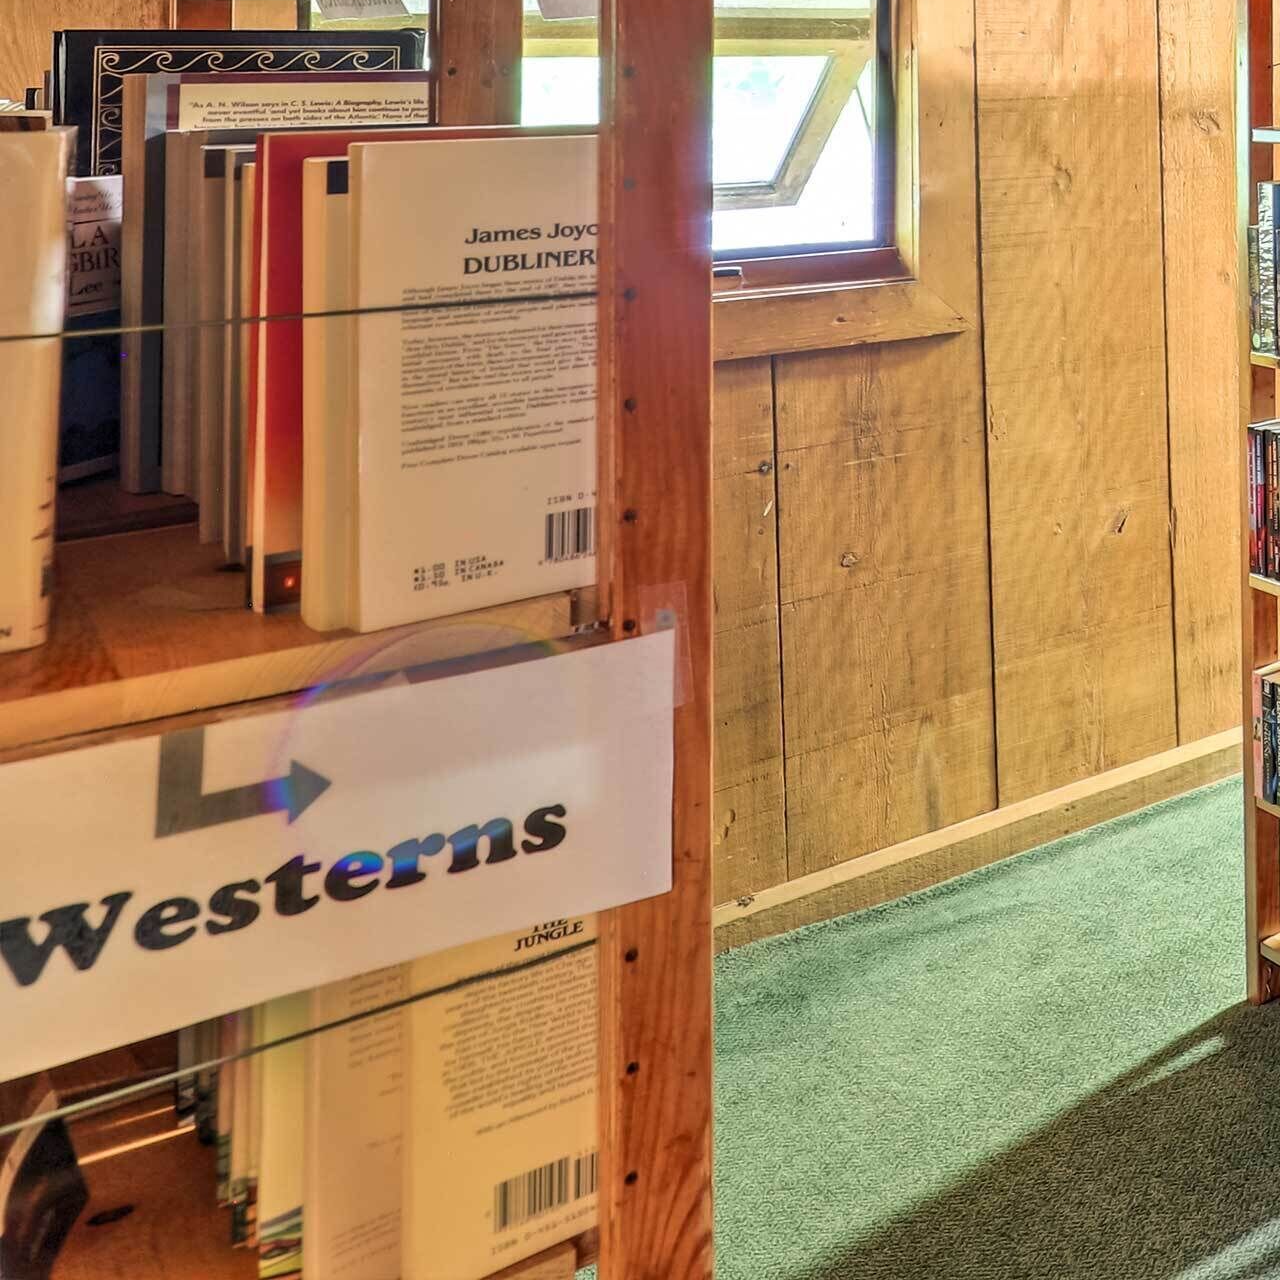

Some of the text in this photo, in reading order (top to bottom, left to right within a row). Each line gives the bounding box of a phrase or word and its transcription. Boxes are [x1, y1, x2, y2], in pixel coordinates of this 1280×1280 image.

[465, 222, 599, 245] James Joyc
[464, 248, 598, 275] DUBLINER
[0, 803, 568, 988] Westerns
[514, 921, 584, 952] JUNGLE
